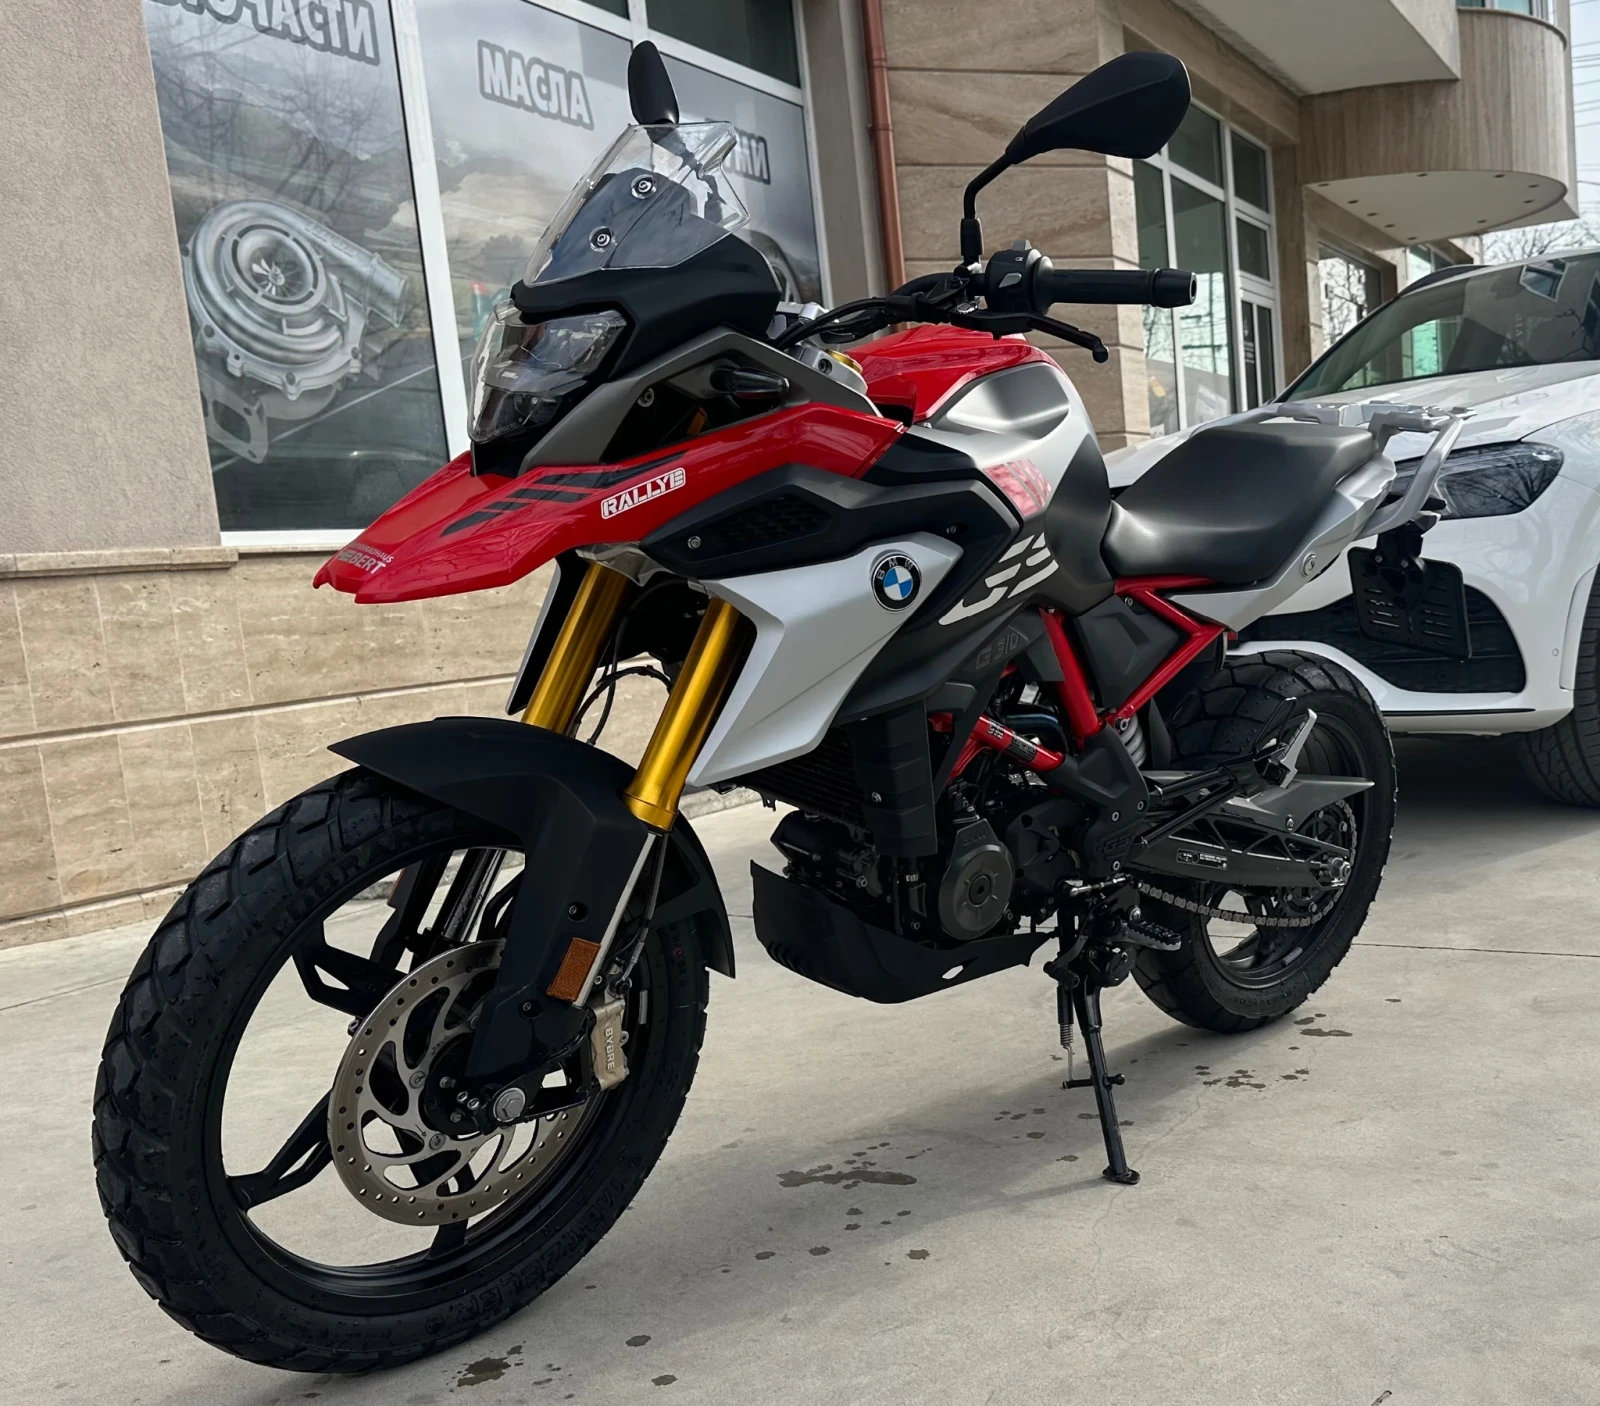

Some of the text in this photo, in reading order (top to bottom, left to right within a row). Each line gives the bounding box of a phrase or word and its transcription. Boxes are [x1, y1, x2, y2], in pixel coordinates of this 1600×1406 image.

[479, 41, 593, 129] МАСЛА
[602, 468, 685, 518] RALLYE
[337, 548, 387, 575] EBERT
[876, 557, 914, 581] BMW
[605, 1027, 616, 1070] BYBRE
